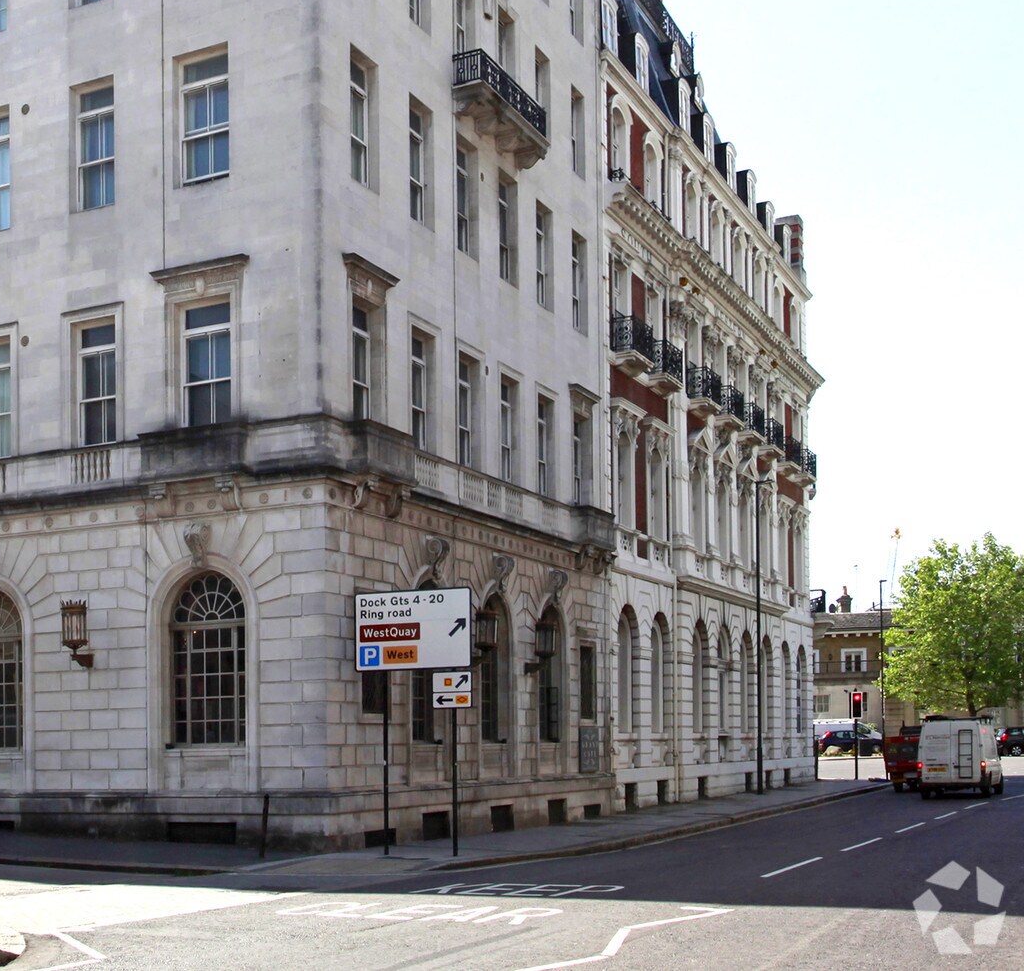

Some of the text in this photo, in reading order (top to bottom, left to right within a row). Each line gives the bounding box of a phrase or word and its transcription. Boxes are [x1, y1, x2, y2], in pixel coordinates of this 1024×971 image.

[360, 598, 386, 607] Dock
[391, 597, 409, 606] Gts
[360, 608, 412, 620] Ring road
[363, 627, 416, 638] WestQuay
[365, 648, 414, 665] P West
[409, 883, 625, 897] KEEP
[276, 902, 563, 925] CLEAR
